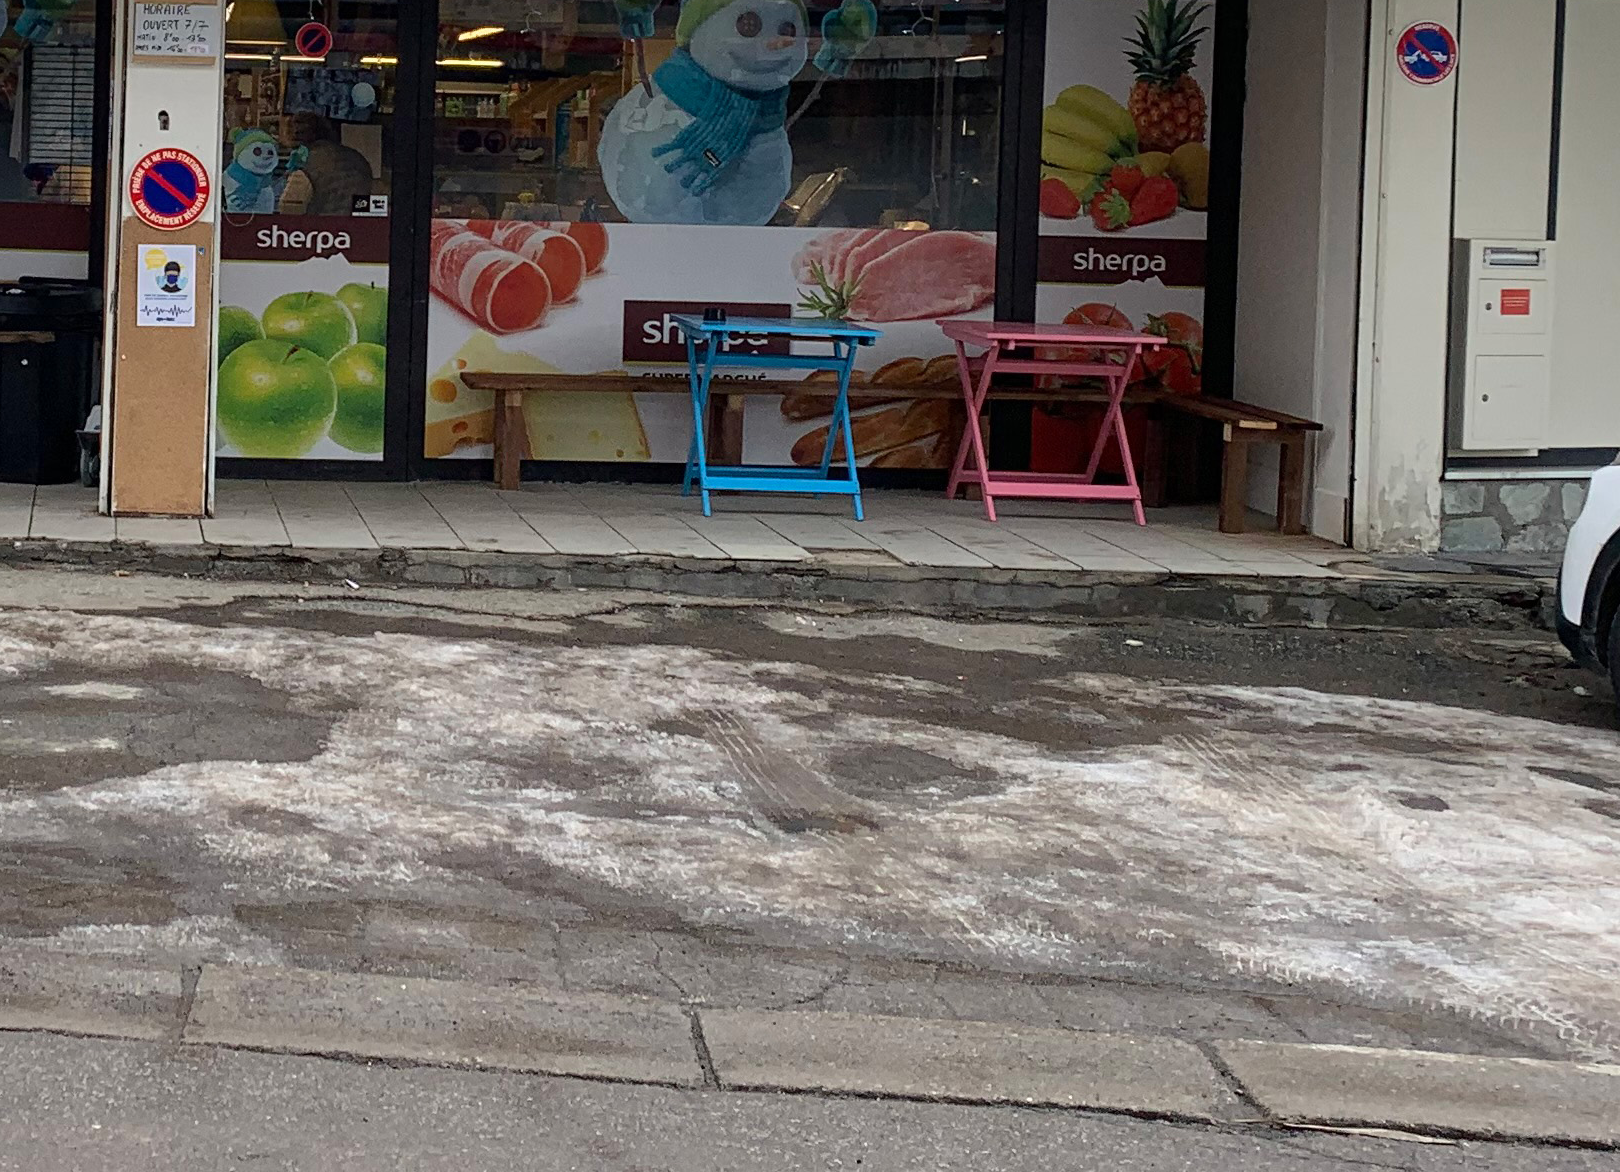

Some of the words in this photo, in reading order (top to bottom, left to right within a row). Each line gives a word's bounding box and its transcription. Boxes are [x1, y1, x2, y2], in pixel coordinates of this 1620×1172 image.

[143, 3, 191, 16] HORAIRE
[143, 19, 179, 31] OUVERT
[184, 19, 210, 33] 7/7
[141, 158, 153, 169] DE
[150, 153, 162, 163] NE
[162, 150, 177, 159] PAS
[135, 198, 184, 226] EMPLACEMENT
[256, 224, 351, 254] sherpa
[1073, 246, 1167, 277] sherpa
